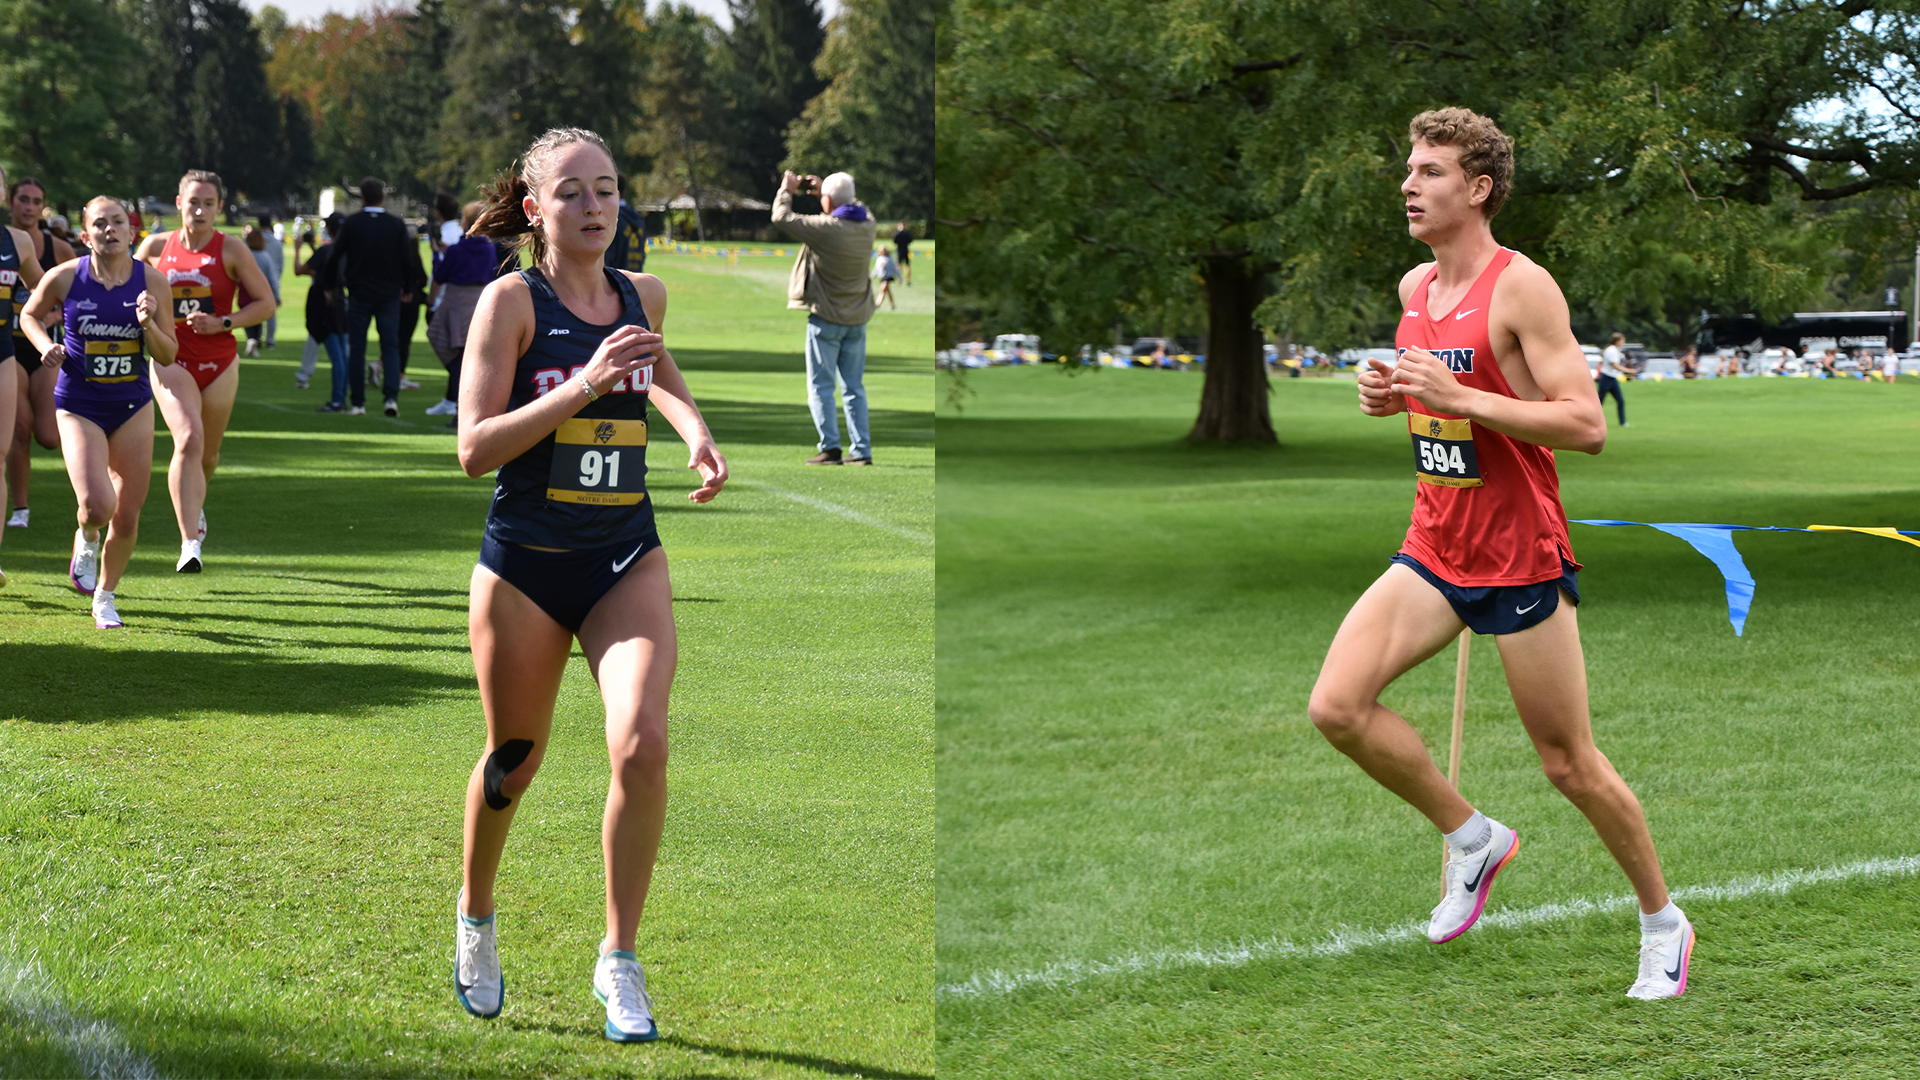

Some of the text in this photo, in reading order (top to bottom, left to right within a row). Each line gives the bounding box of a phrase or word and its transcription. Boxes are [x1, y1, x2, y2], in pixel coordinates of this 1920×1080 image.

[0, 268, 18, 287] ON
[77, 314, 143, 339] Tommies
[93, 356, 132, 376] 375
[1419, 440, 1466, 474] 594
[579, 450, 620, 487] 91
[577, 495, 601, 503] NOTRE
